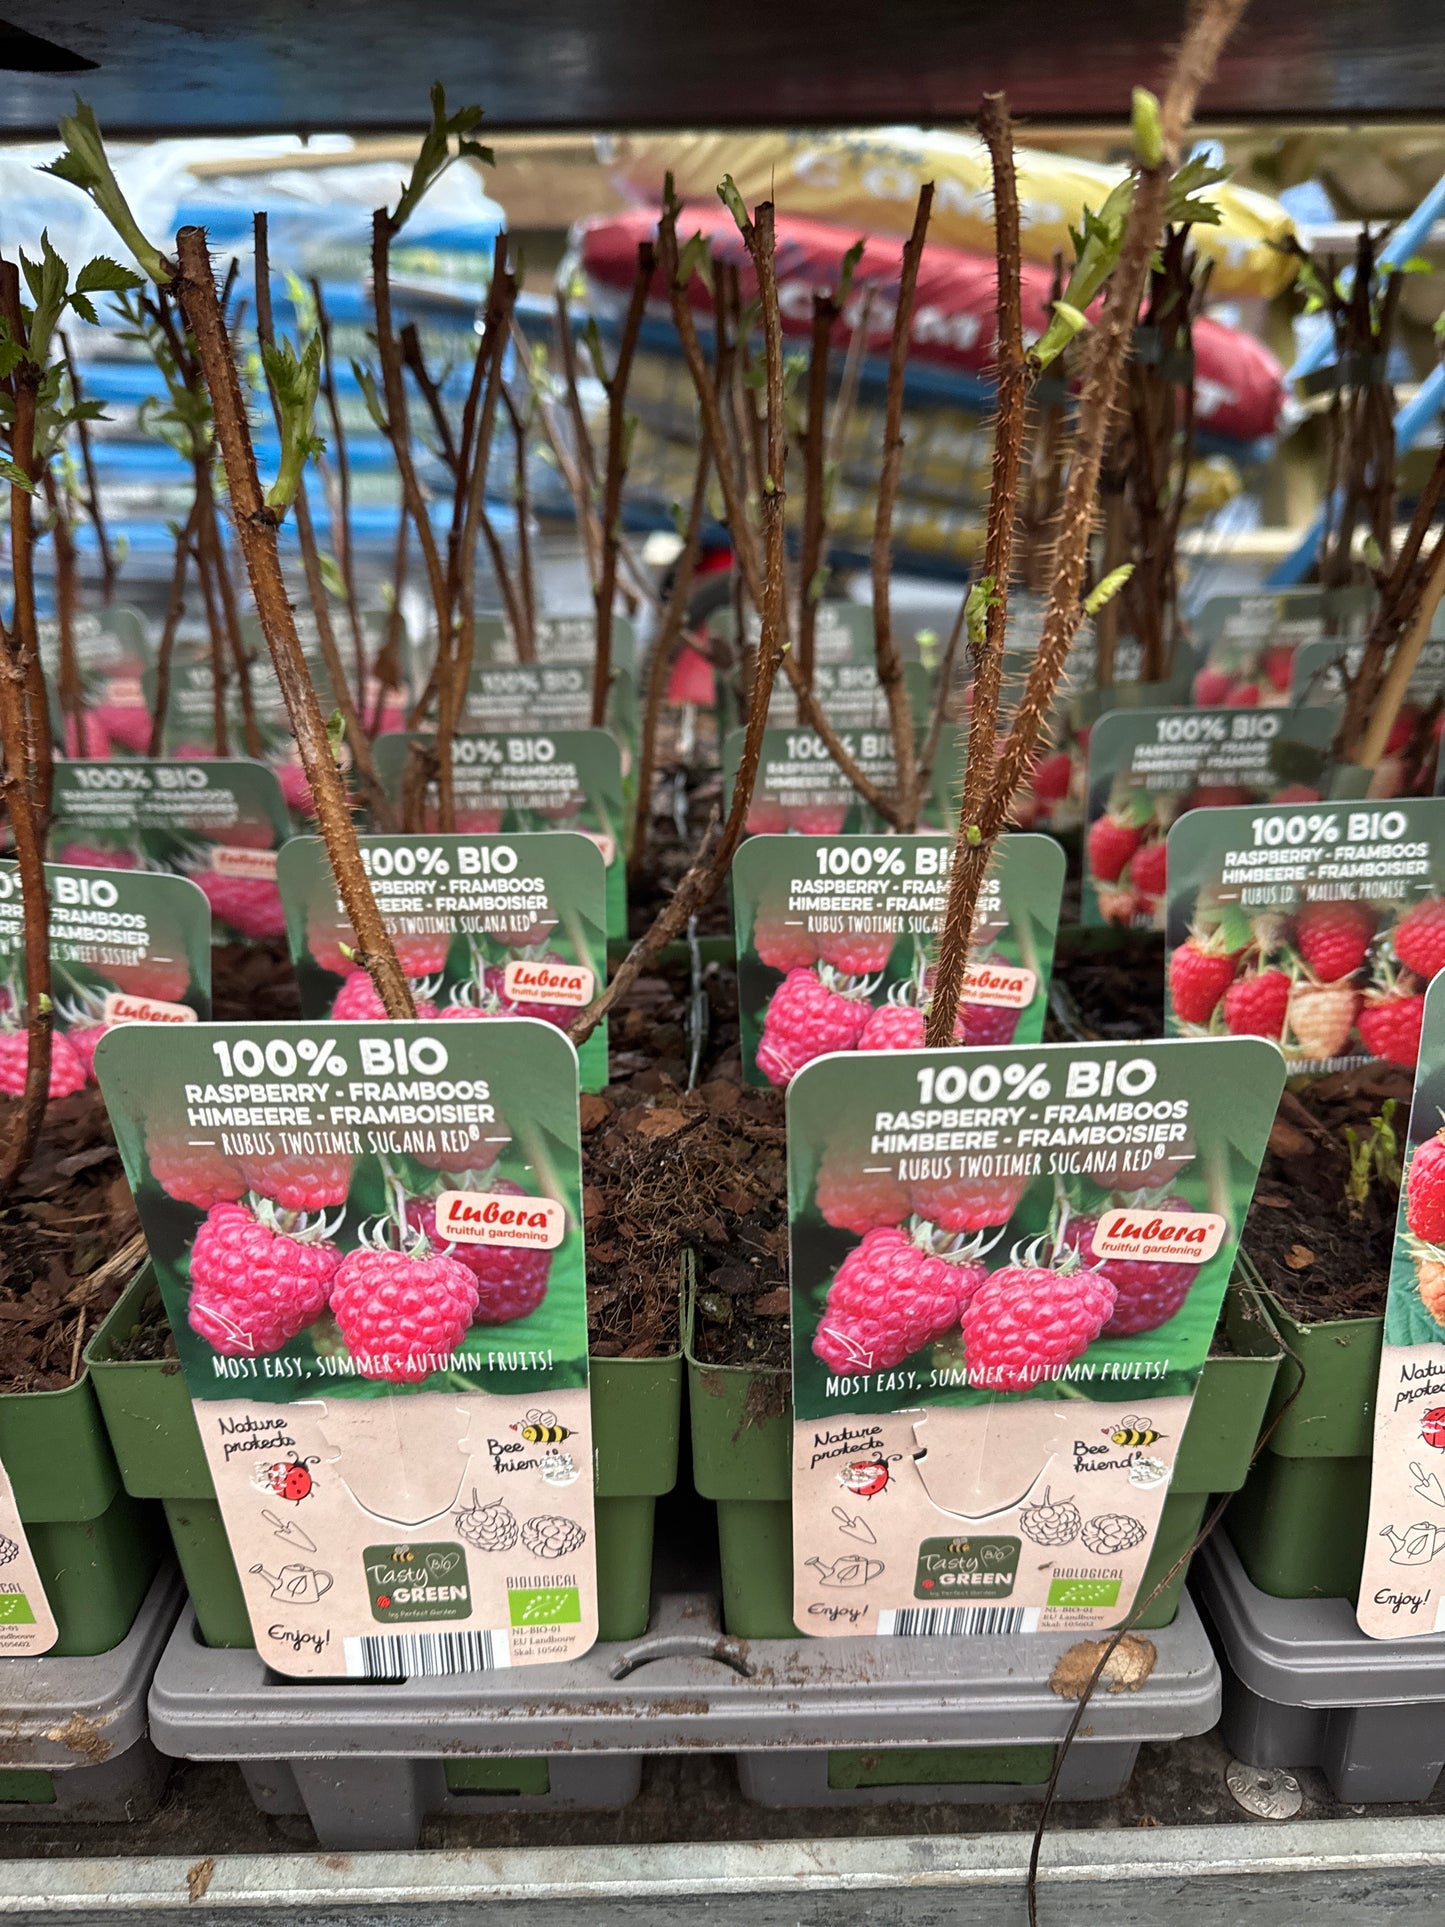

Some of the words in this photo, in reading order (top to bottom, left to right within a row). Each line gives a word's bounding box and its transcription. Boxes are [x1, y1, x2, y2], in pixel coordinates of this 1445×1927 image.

[1156, 716, 1226, 742] 100%
[1231, 714, 1280, 739] BIO
[507, 738, 555, 762] BIO
[73, 768, 152, 789] 100%
[154, 767, 208, 788] BIO
[1252, 815, 1339, 846] 100%
[1347, 811, 1407, 841] BIO
[359, 847, 450, 876] 100%
[458, 846, 518, 874] BIO
[816, 847, 906, 875] 100%
[914, 847, 957, 875] BI
[1225, 848, 1322, 866] RASPBERRY
[1335, 843, 1428, 861] FRAMBOOS
[1222, 865, 1306, 884] HIMBEERE
[1317, 860, 1429, 879] FRAMBOISIER
[54, 876, 118, 907] BIO
[371, 880, 437, 895] PBERRY
[449, 878, 545, 894] FRAMBOOS
[790, 880, 889, 894] RASPBERRY
[1241, 886, 1276, 904] RUBUS
[435, 895, 548, 911] FRAMBOISIER
[788, 897, 873, 911] HIMBEERE
[48, 924, 150, 946] RAMBOISIER
[399, 915, 458, 934] TWOTIMER
[459, 915, 507, 933] SUGANA
[808, 915, 844, 933] RUBUS
[848, 915, 903, 933] TWOTIMER
[963, 970, 1023, 991] ubera
[213, 1038, 348, 1078] 100%
[360, 1037, 448, 1077] BIO
[185, 1083, 330, 1104] RASPBERRY
[349, 1080, 490, 1103] FRAMBOOS
[917, 1062, 1051, 1104] 100%
[1065, 1058, 1157, 1099] BIO
[187, 1106, 311, 1126] HIMBEERE
[331, 1104, 495, 1124] FRAMBOISIER
[874, 1107, 1023, 1131] RASPBERRY
[1044, 1100, 1188, 1125] FRAMBOOS
[221, 1133, 275, 1155] RUBUS
[280, 1131, 364, 1155] TWOTIMER
[369, 1130, 436, 1154] SUGANA
[870, 1130, 999, 1154] HIMBEERE
[1017, 1123, 1187, 1148] FRAMBOISIER
[898, 1158, 952, 1181] RUBUS
[958, 1155, 1041, 1179] TWOTIMER
[1047, 1151, 1118, 1176] SUGANA
[445, 1224, 485, 1239] fruitful
[488, 1228, 549, 1243] gardening
[1101, 1241, 1140, 1255] fruitful
[1142, 1244, 1203, 1258] gardening
[211, 1355, 258, 1380] MOST
[263, 1356, 312, 1380] EASY,
[488, 1349, 554, 1373] FRUITS!
[1400, 1360, 1445, 1383] Natu
[825, 1375, 871, 1398] MOST
[876, 1371, 922, 1393] EASY,
[1101, 1359, 1169, 1382] FRUITS!
[1394, 1379, 1445, 1412] protec
[218, 1417, 288, 1436] Nature
[814, 1424, 883, 1448] Nature
[223, 1436, 296, 1461] protects
[487, 1438, 525, 1456] Bee
[810, 1439, 884, 1469] protects
[1073, 1440, 1110, 1456] Bee
[920, 1554, 978, 1574] Tasty
[1052, 1568, 1123, 1579] BIOLOGICAL
[367, 1564, 429, 1589] Tasty
[506, 1573, 577, 1589] BIOLOGICAL
[939, 1572, 1012, 1586] GREEN
[393, 1584, 468, 1603] GREEN
[1374, 1588, 1431, 1614] Enjoy!
[807, 1602, 868, 1623] Enjoy!
[268, 1623, 331, 1654] Enjoy!
